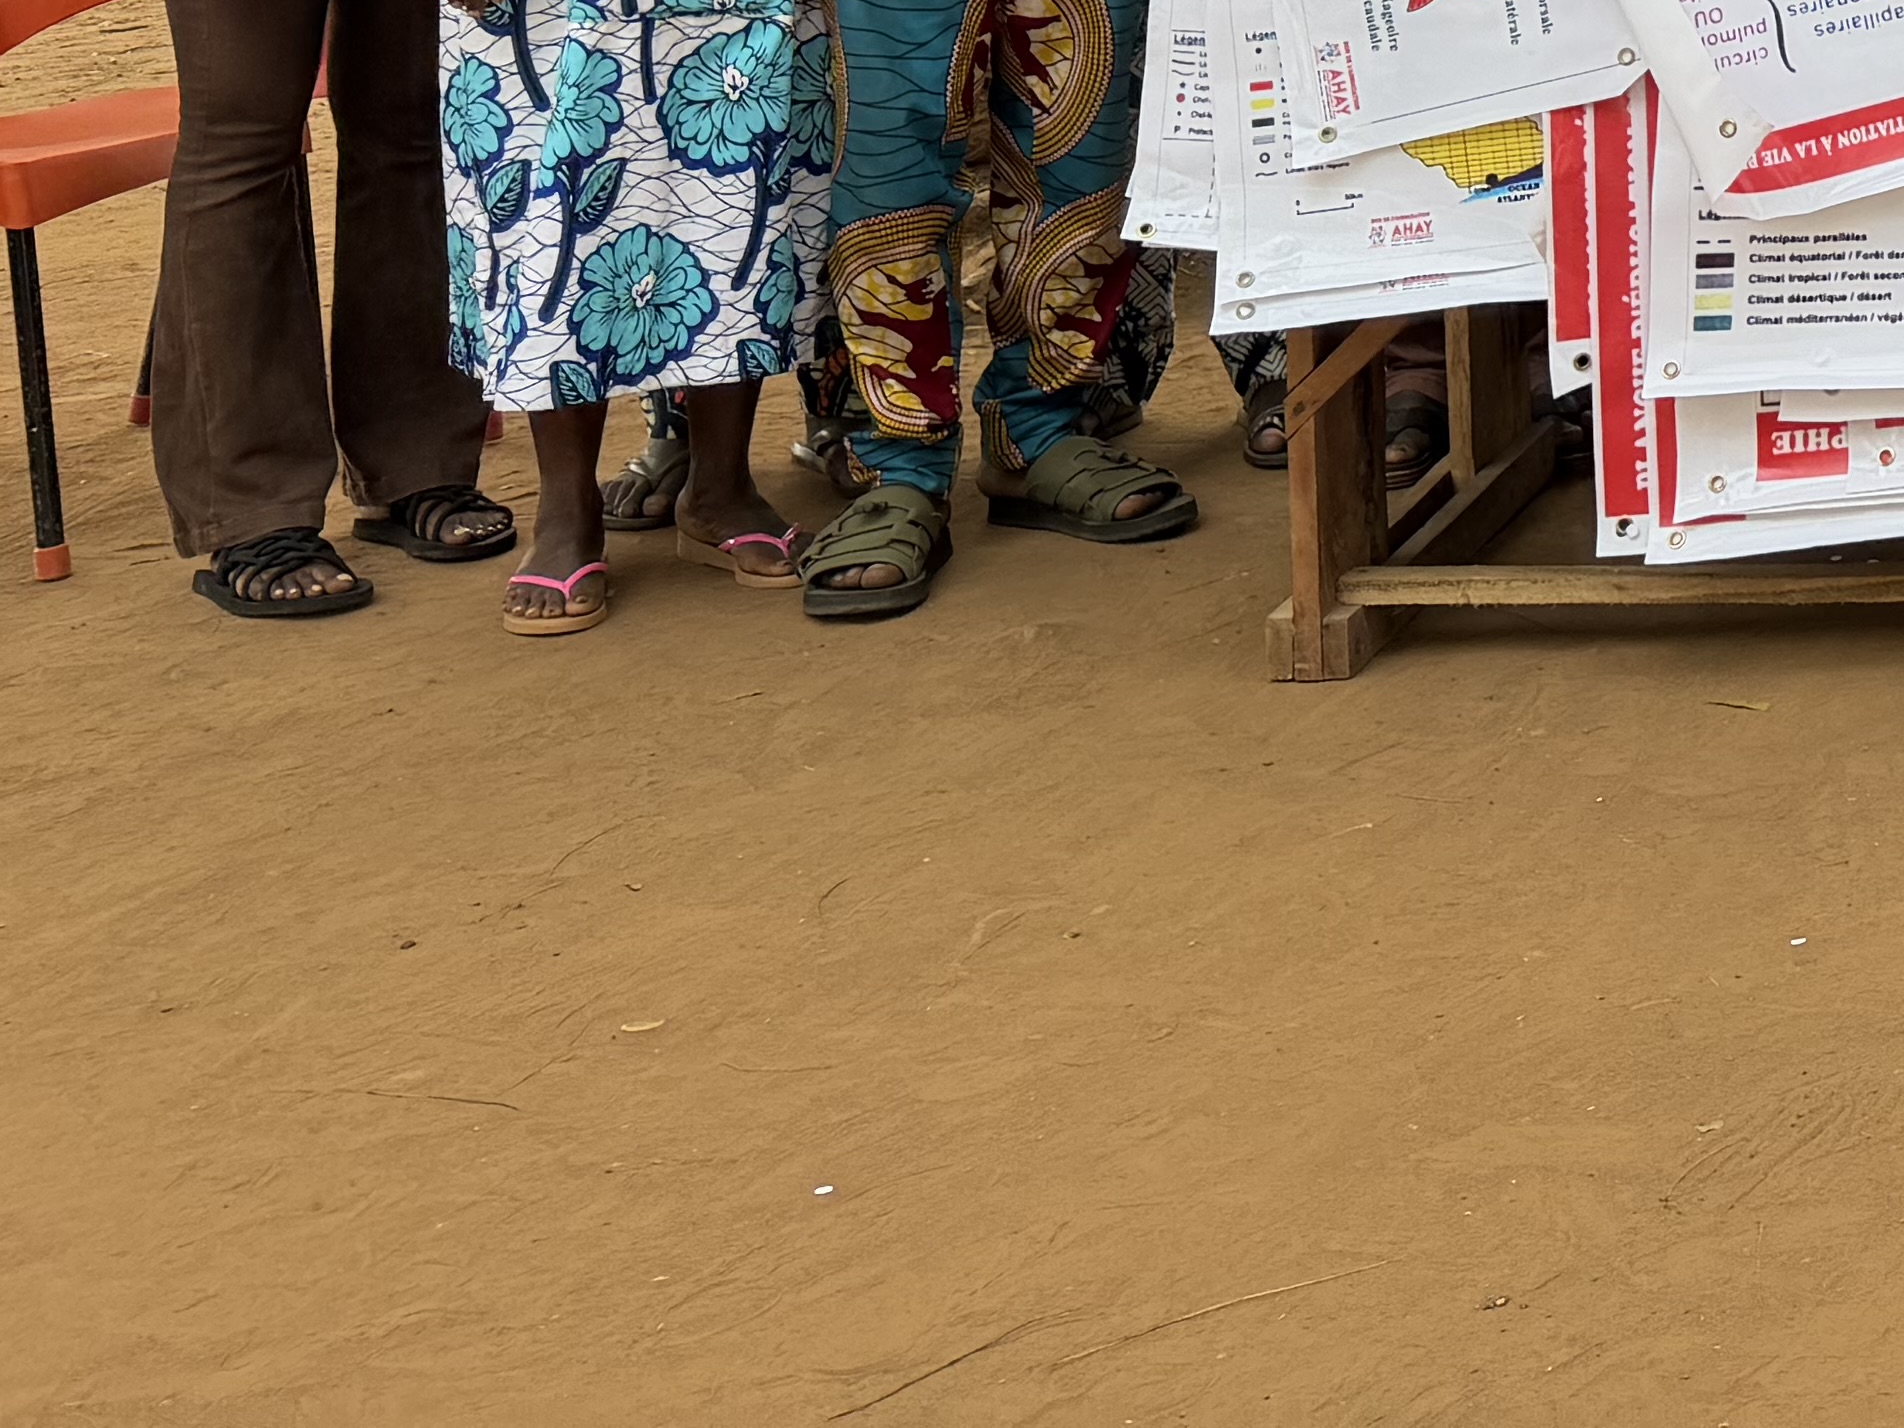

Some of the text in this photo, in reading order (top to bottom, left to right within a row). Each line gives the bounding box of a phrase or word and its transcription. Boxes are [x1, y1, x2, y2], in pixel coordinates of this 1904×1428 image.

[1364, 0, 1380, 52] caudale
[1695, 7, 1723, 28] OU
[1328, 70, 1352, 115] AHAY
[1794, 140, 1818, 160] LA
[1820, 135, 1834, 156] À
[1762, 146, 1792, 167] VIE
[1392, 220, 1433, 238] AHAY
[1749, 233, 1867, 245] Principaux parallèles
[1749, 253, 1786, 263] Climat
[1789, 251, 1846, 264] équatorial
[1855, 250, 1885, 260] Forêt
[1748, 274, 1785, 283] Climat
[1788, 272, 1831, 284] tropical
[1841, 271, 1870, 281] Forêt
[1748, 294, 1784, 304] Climat
[1787, 293, 1848, 305] désertique
[1857, 291, 1892, 301] désert
[1746, 315, 1783, 325] Climat
[1786, 314, 1867, 324] méditerranéen
